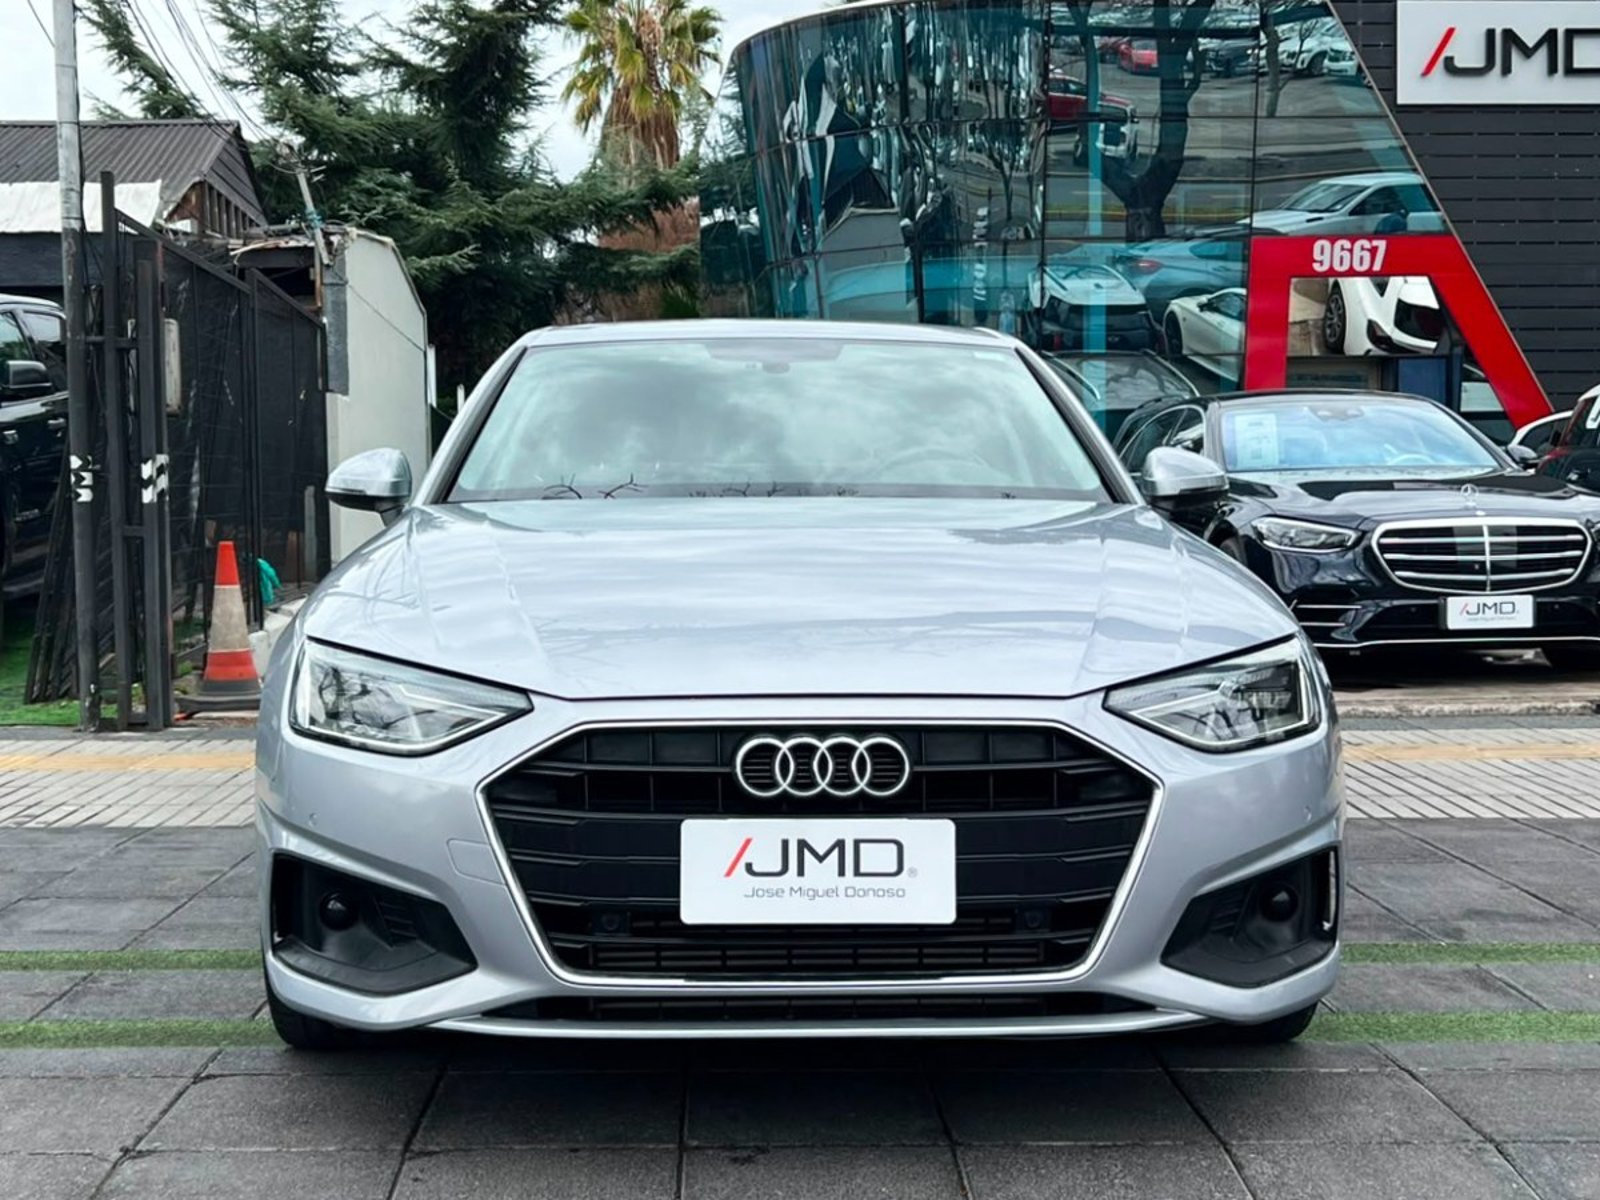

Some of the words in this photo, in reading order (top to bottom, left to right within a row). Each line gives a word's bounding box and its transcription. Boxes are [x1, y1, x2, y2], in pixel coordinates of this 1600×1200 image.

[1312, 239, 1387, 272] 9667
[744, 886, 785, 898] Jose
[789, 886, 839, 901] Miguel
[844, 886, 906, 898] Donoso
